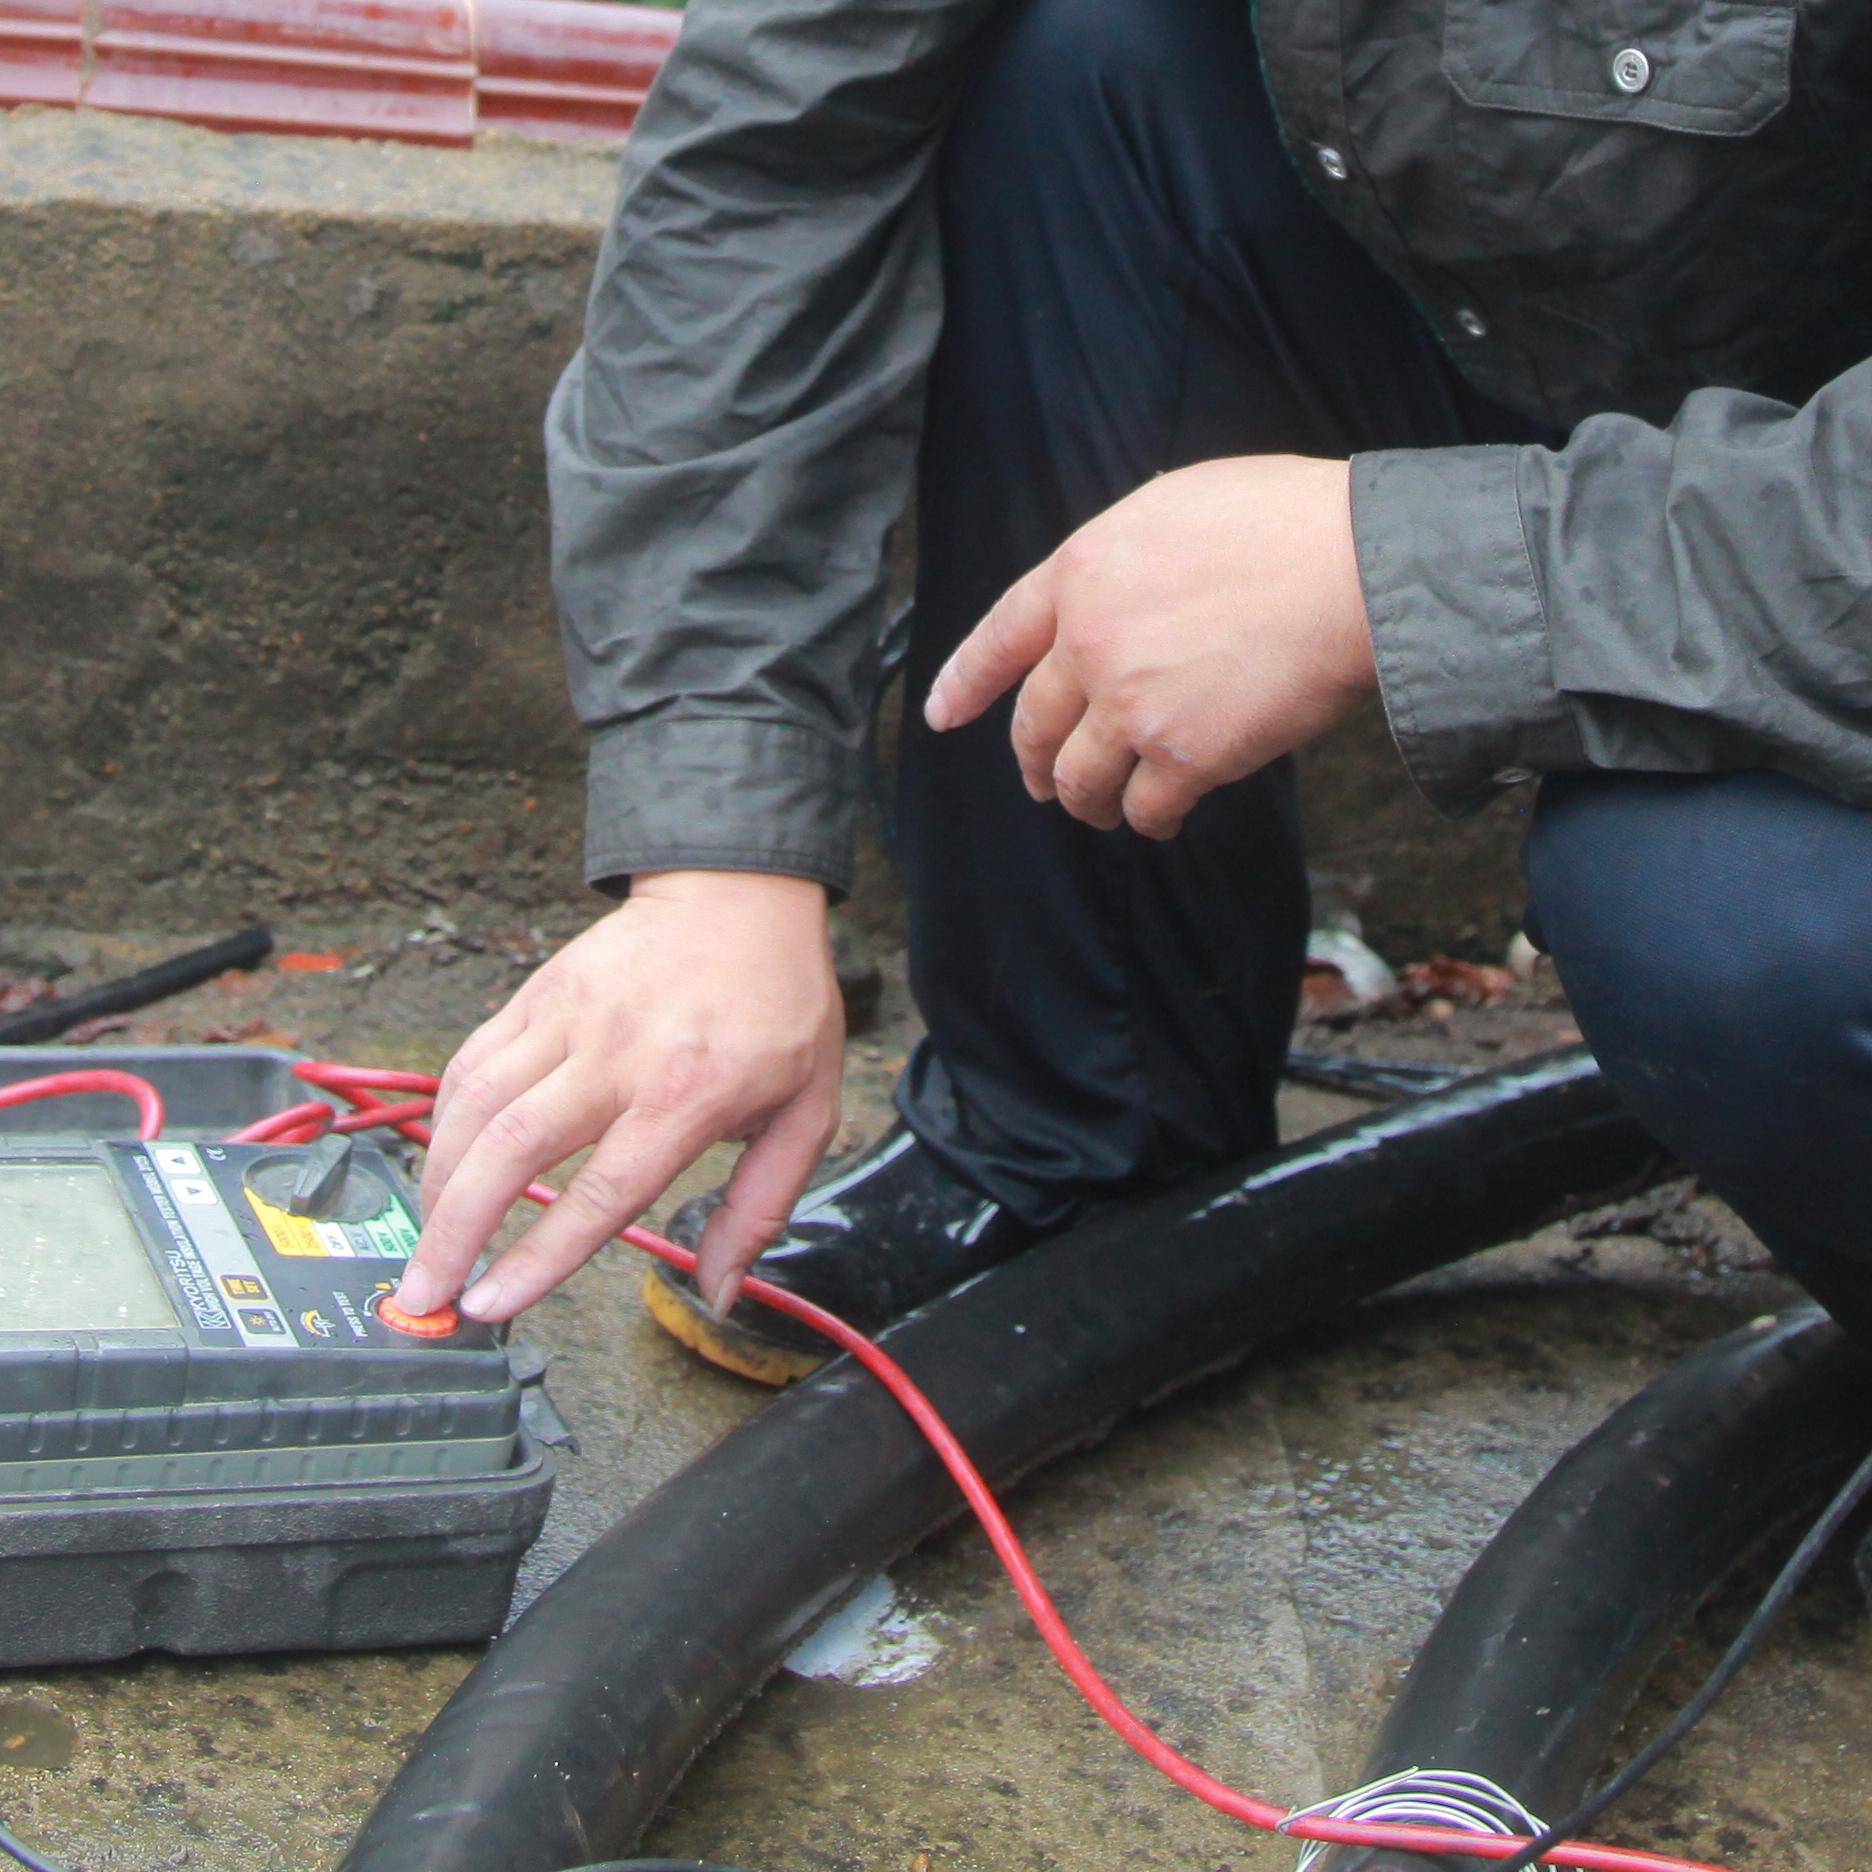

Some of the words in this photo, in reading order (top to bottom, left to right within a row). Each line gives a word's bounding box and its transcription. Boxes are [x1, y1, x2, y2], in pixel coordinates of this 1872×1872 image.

[376, 1232, 398, 1253] 500V
[165, 1249, 207, 1311] KYORITSU
[332, 1291, 351, 1306] TEST
[341, 1307, 356, 1316] TO
[346, 1316, 369, 1338] PRESS
